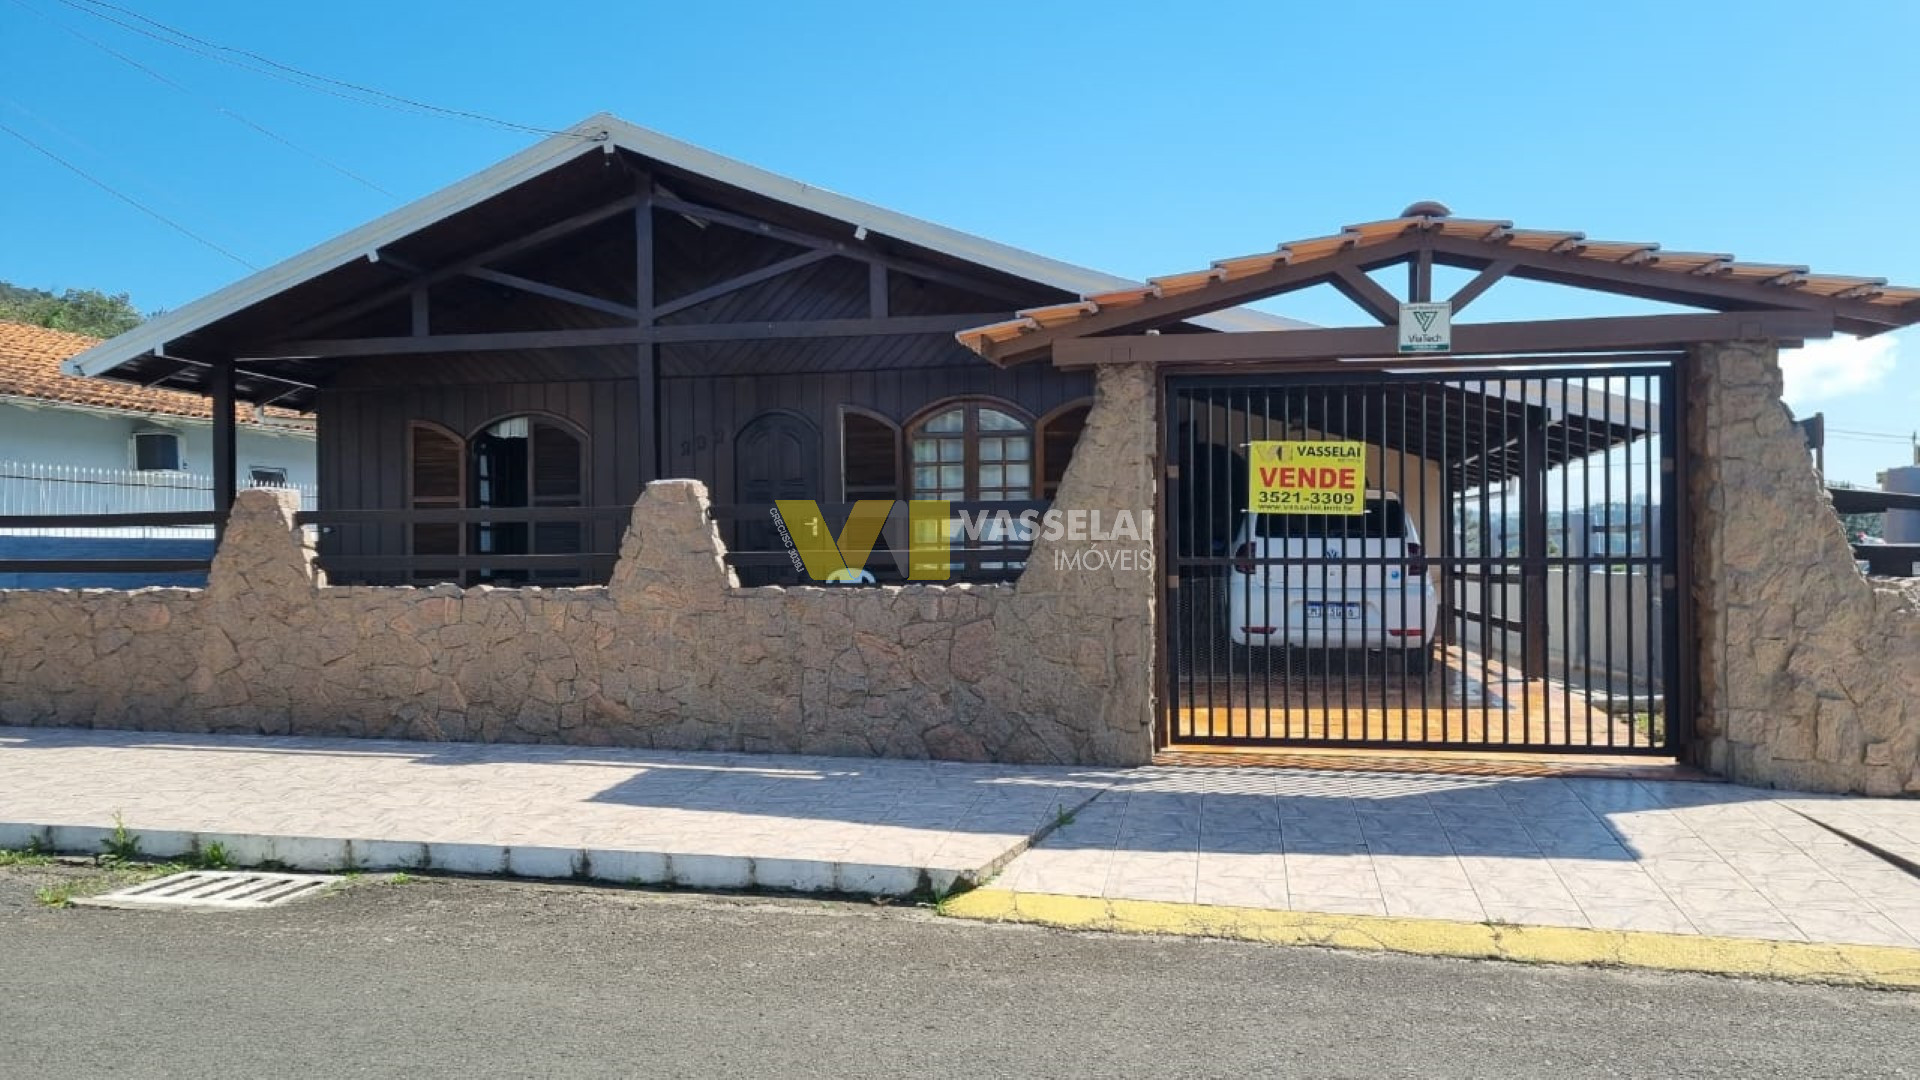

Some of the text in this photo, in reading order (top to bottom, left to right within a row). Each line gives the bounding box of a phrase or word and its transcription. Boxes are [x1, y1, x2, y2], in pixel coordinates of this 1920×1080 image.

[1297, 446, 1361, 457] VASSELAI
[1259, 467, 1355, 489] VENDE
[1259, 491, 1354, 504] 3521-3309
